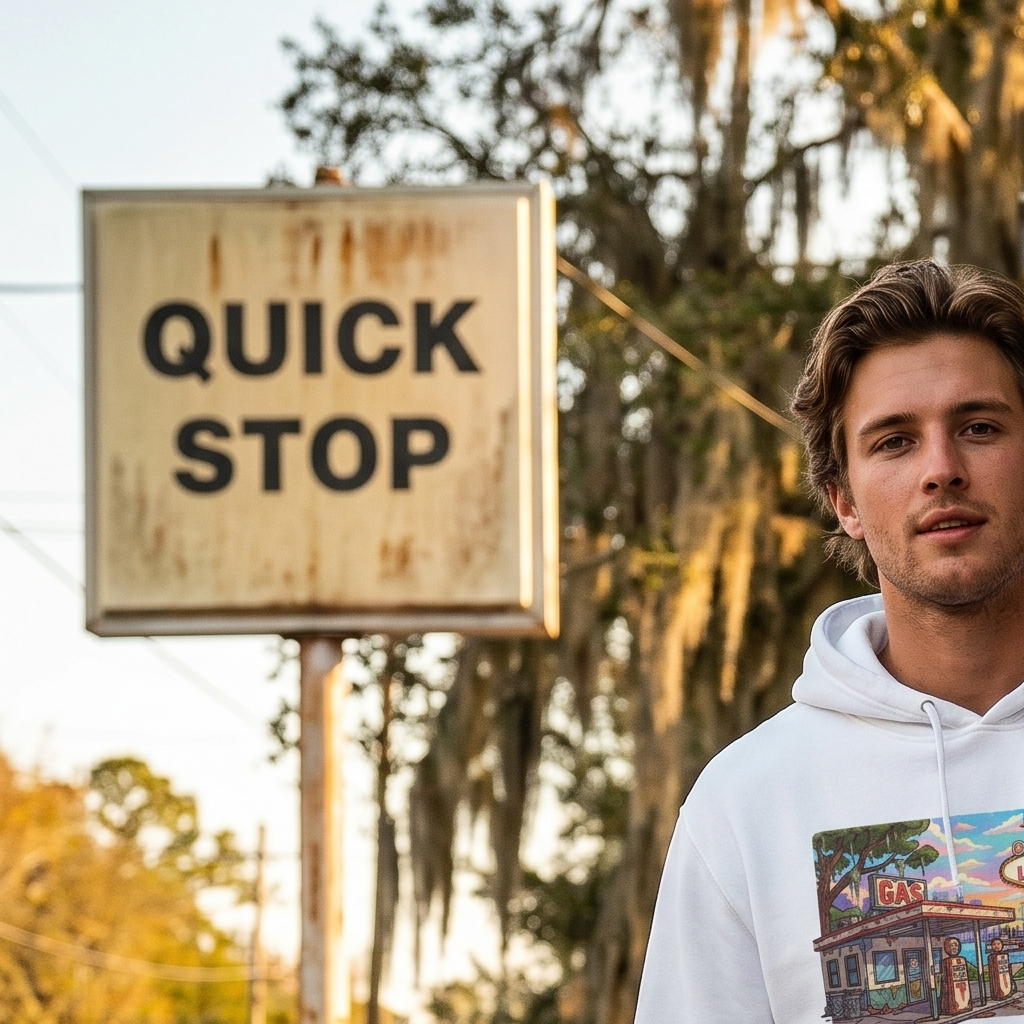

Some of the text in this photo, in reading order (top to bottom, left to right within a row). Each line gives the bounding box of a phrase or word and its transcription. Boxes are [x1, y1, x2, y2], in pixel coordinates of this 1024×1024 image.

[142, 300, 482, 383] QUICK
[174, 416, 452, 494] STOP
[878, 879, 924, 905] GAS
